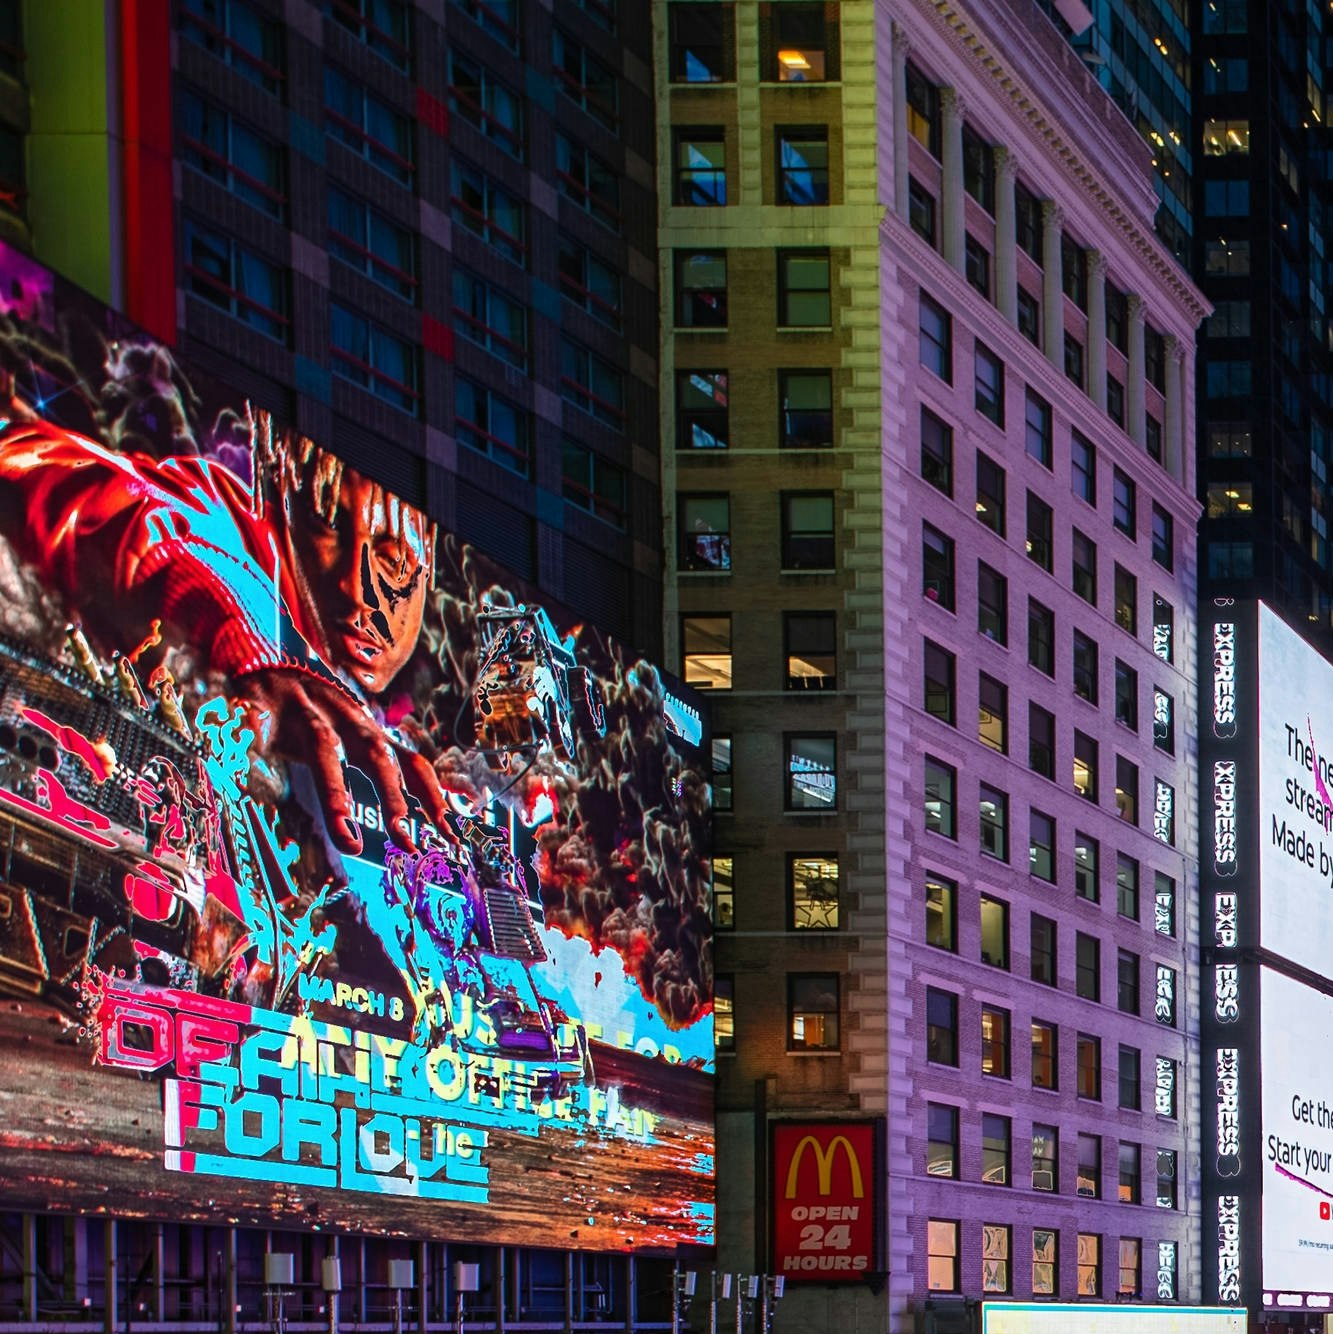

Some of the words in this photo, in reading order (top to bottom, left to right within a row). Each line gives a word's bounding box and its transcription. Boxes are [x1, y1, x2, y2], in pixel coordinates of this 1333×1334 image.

[1285, 723, 1314, 771] The
[1272, 813, 1314, 868] Made
[299, 973, 385, 1017] MARCH
[389, 994, 404, 1021] 8
[1292, 1094, 1314, 1126] Get
[1268, 1134, 1300, 1167] Start
[1304, 1146, 1331, 1176] your
[790, 1206, 860, 1221] OPEN
[798, 1224, 852, 1250] 24
[783, 1255, 868, 1270] HOURS
